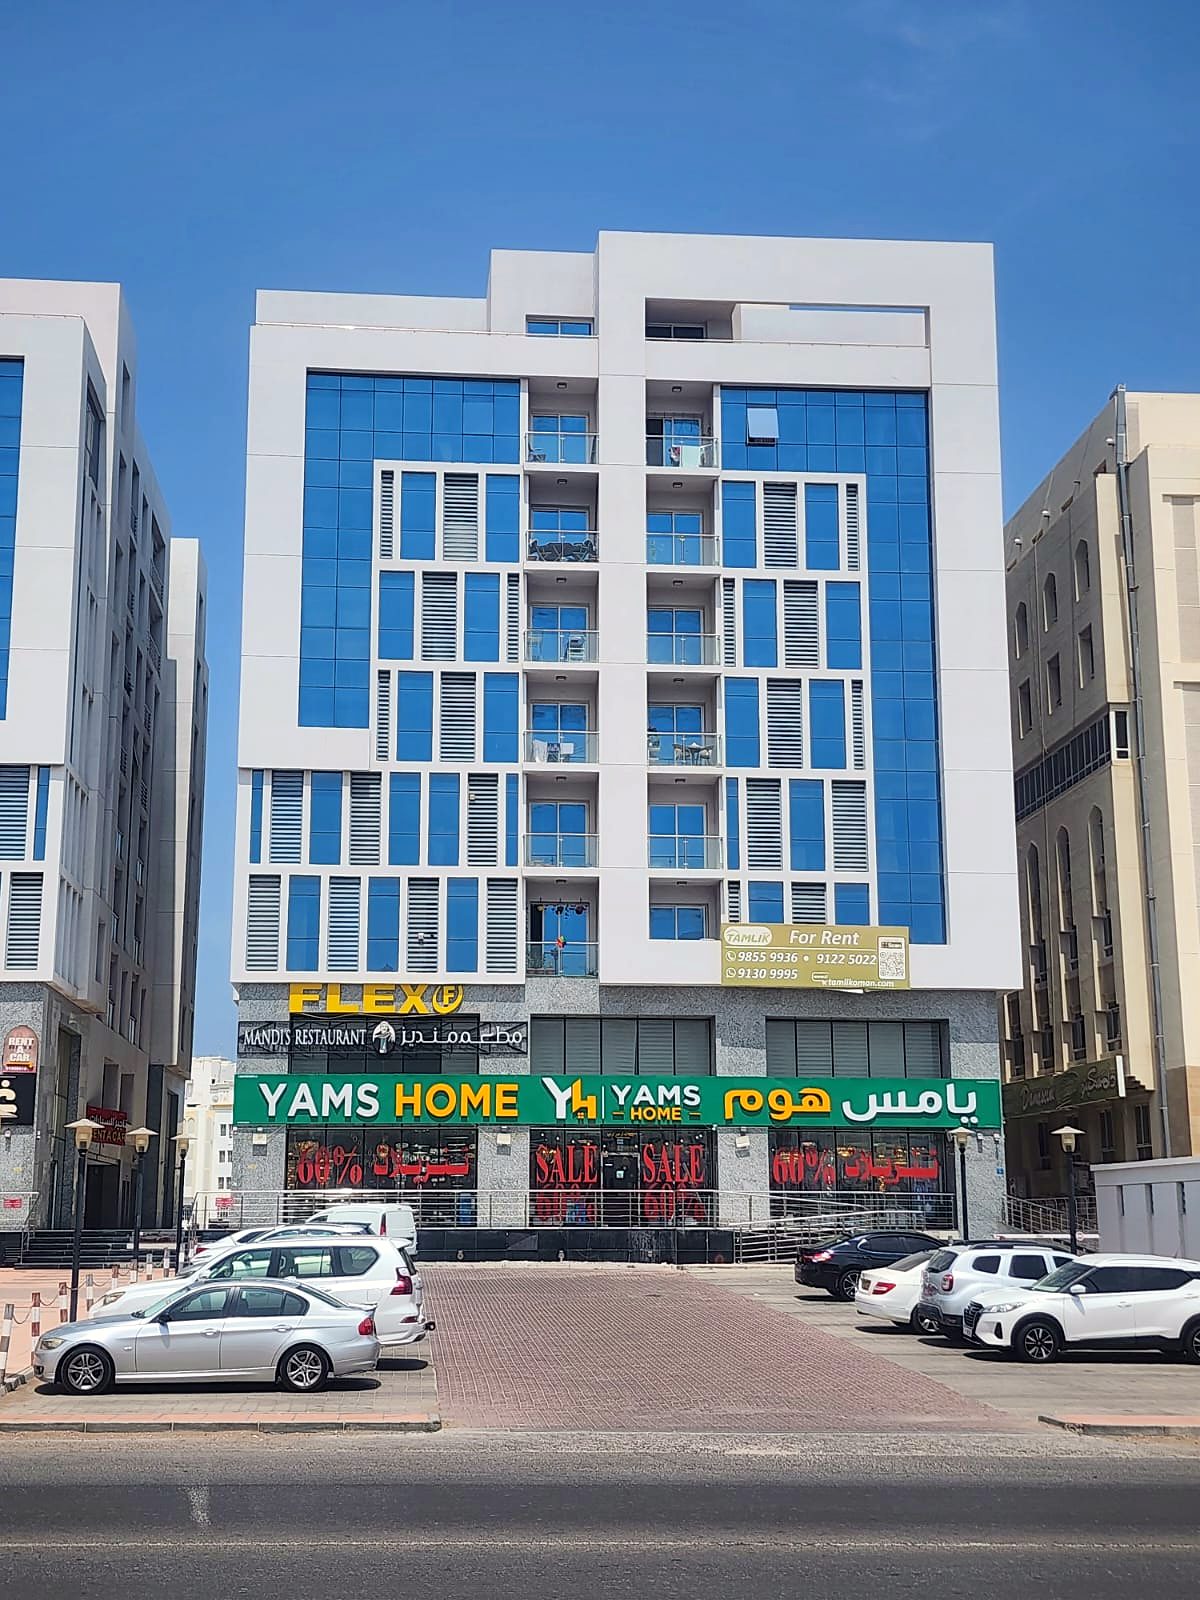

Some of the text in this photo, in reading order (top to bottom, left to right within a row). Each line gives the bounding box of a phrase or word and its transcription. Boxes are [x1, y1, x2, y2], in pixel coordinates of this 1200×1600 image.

[727, 931, 770, 943] TAMLIK
[789, 930, 860, 946] For Rent
[738, 951, 877, 965] 9855 9936 9122 5022
[738, 967, 798, 980] 9130 9995
[289, 983, 429, 1013] FLEX
[8, 1037, 35, 1046] RENT
[295, 1028, 367, 1046] RESTAURANT
[9, 1053, 31, 1062] CAR
[16, 1046, 24, 1054] A
[258, 1083, 519, 1118] YAMS HOME
[611, 1085, 701, 1106] YAMS
[724, 1087, 832, 1121] هوم
[841, 1083, 979, 1124] يامس
[630, 1107, 683, 1121] HOME
[296, 1145, 363, 1185] 60%
[536, 1143, 598, 1183] SALE
[643, 1143, 705, 1184] SALE
[773, 1147, 836, 1186] 60%
